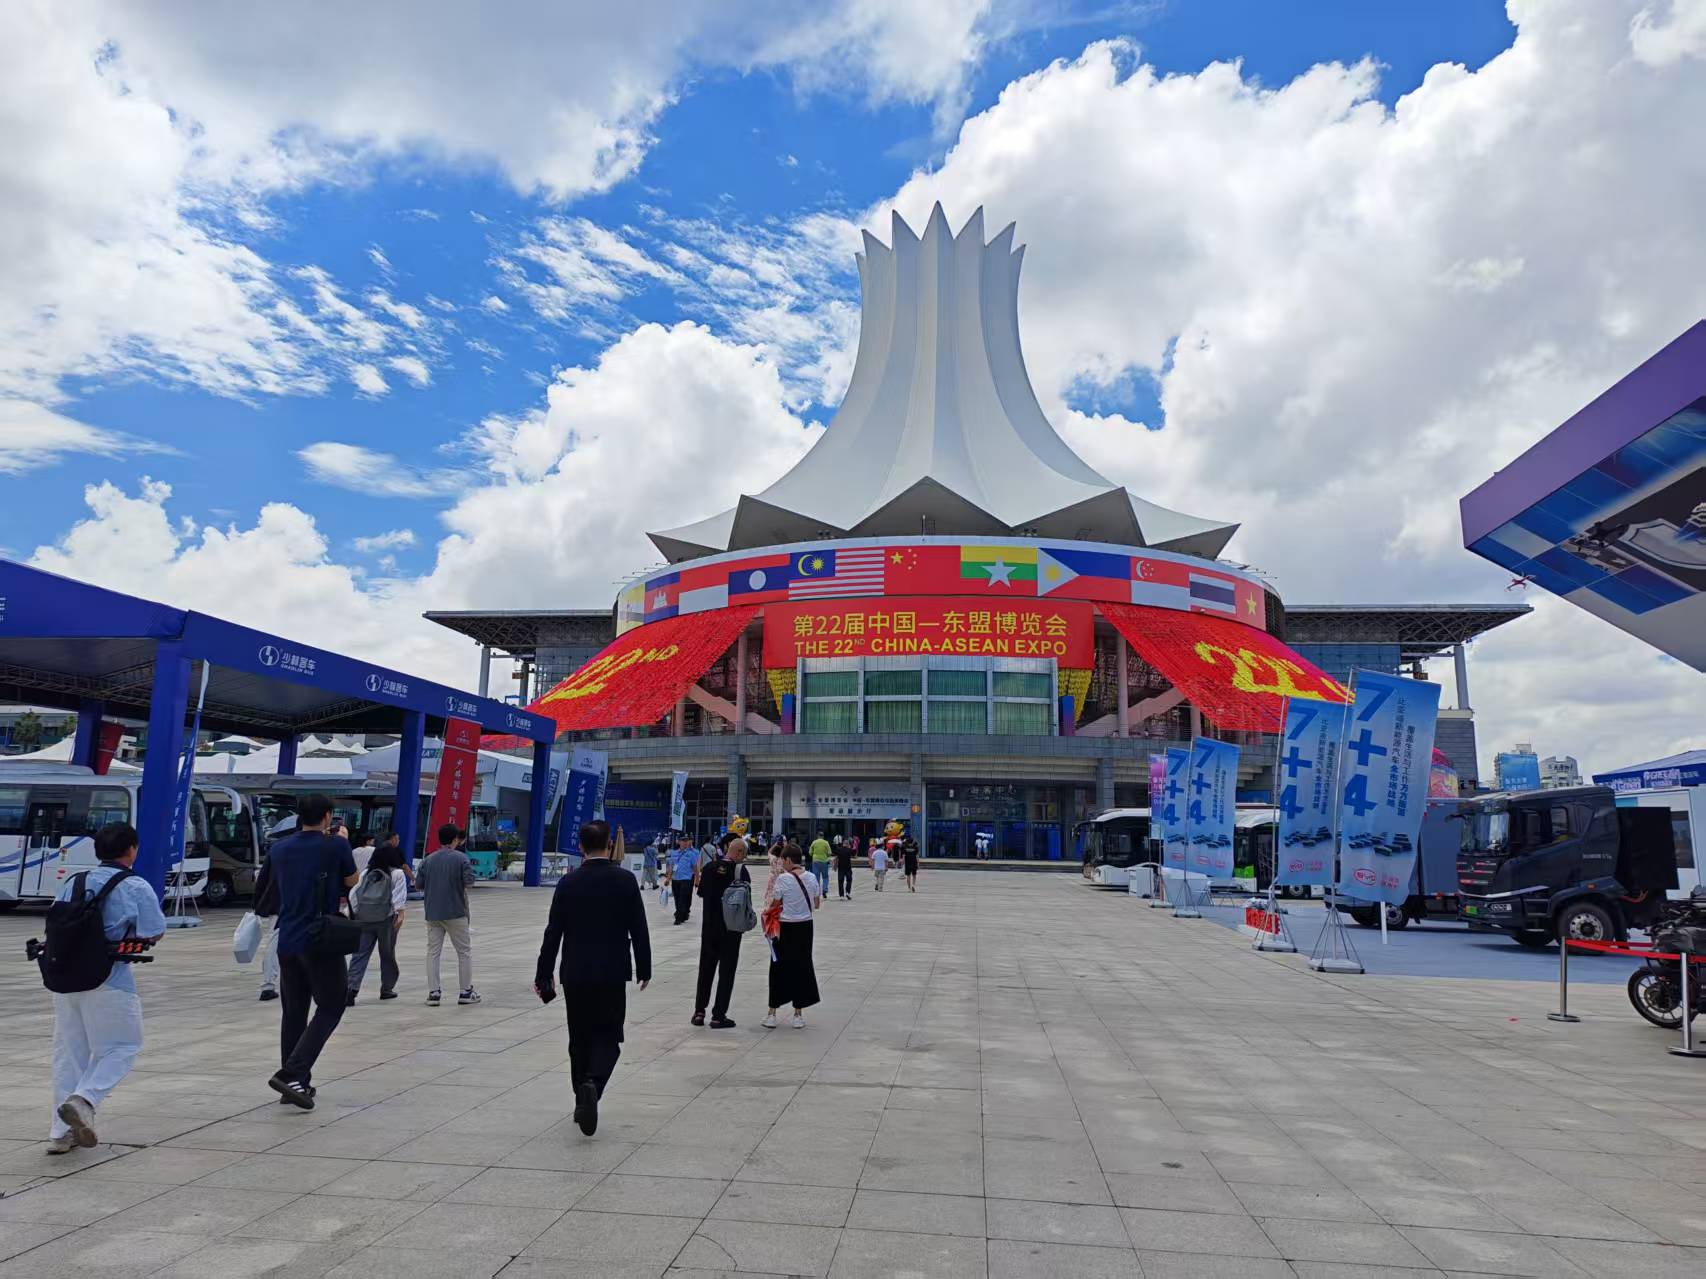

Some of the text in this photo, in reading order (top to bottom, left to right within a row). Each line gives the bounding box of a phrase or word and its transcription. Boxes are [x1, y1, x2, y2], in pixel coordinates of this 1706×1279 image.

[281, 652, 317, 671] 少林客车
[794, 640, 829, 655] THE
[870, 638, 1009, 653] CHINA-ASEAN
[1014, 640, 1068, 656] EXPO
[1280, 705, 1319, 819] 7+4
[1344, 680, 1396, 817] 7+4
